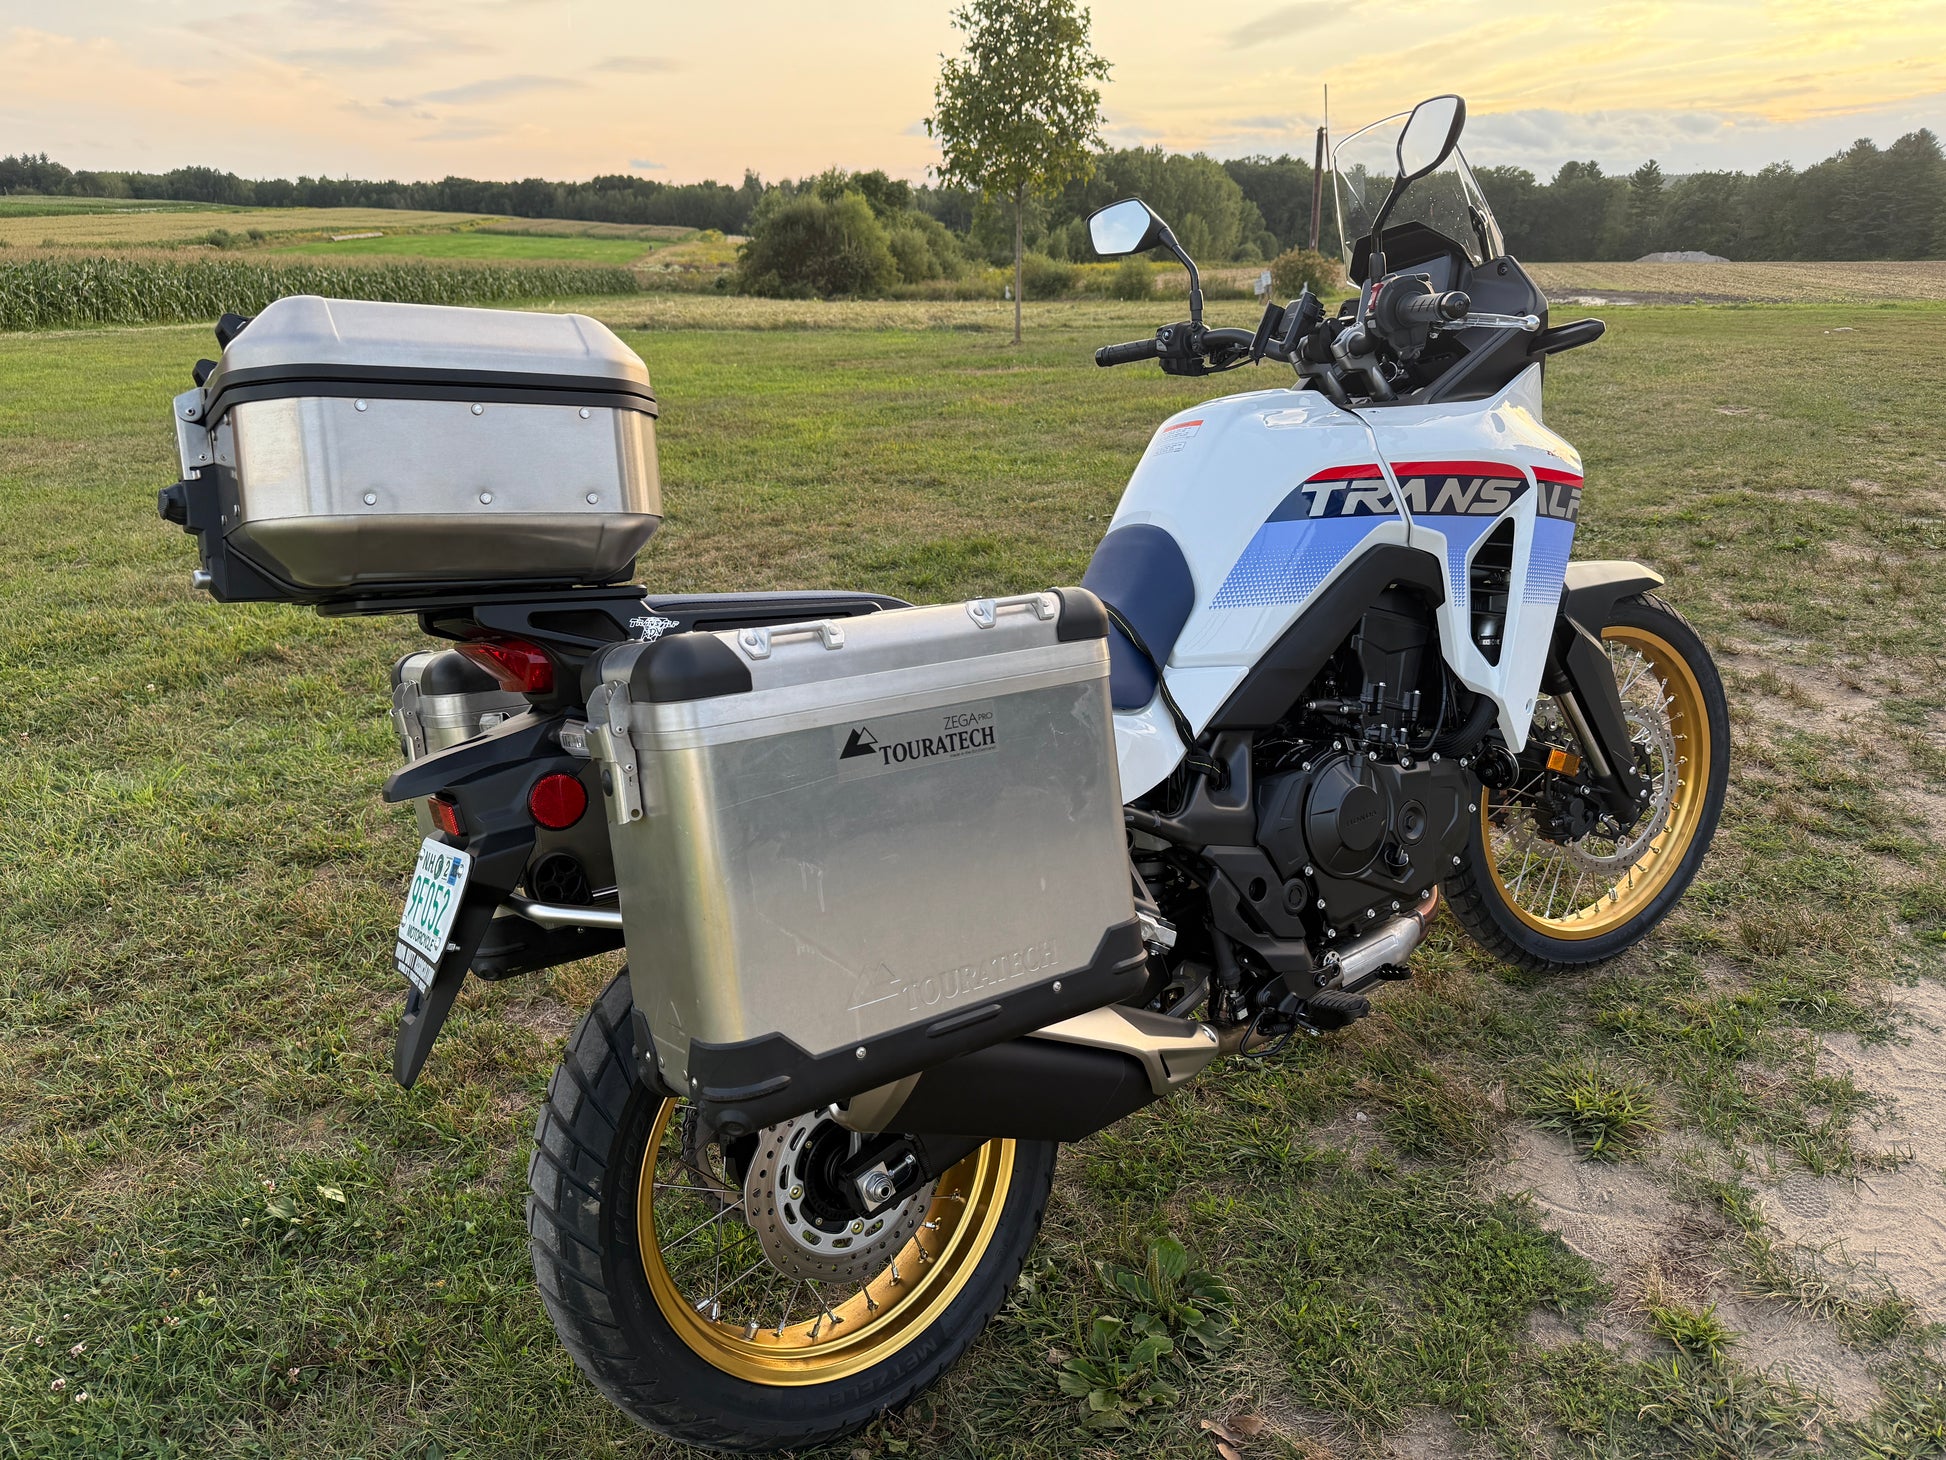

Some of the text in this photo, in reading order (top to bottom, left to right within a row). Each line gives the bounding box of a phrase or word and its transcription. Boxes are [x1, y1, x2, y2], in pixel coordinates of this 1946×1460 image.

[943, 711, 993, 730] ZEGA PRO
[878, 726, 996, 765] TOURATECH
[422, 850, 437, 873] NH
[407, 875, 451, 937] 9F052
[406, 925, 435, 953] MOTORCYCLE
[903, 939, 1059, 1010] TOURATECH
